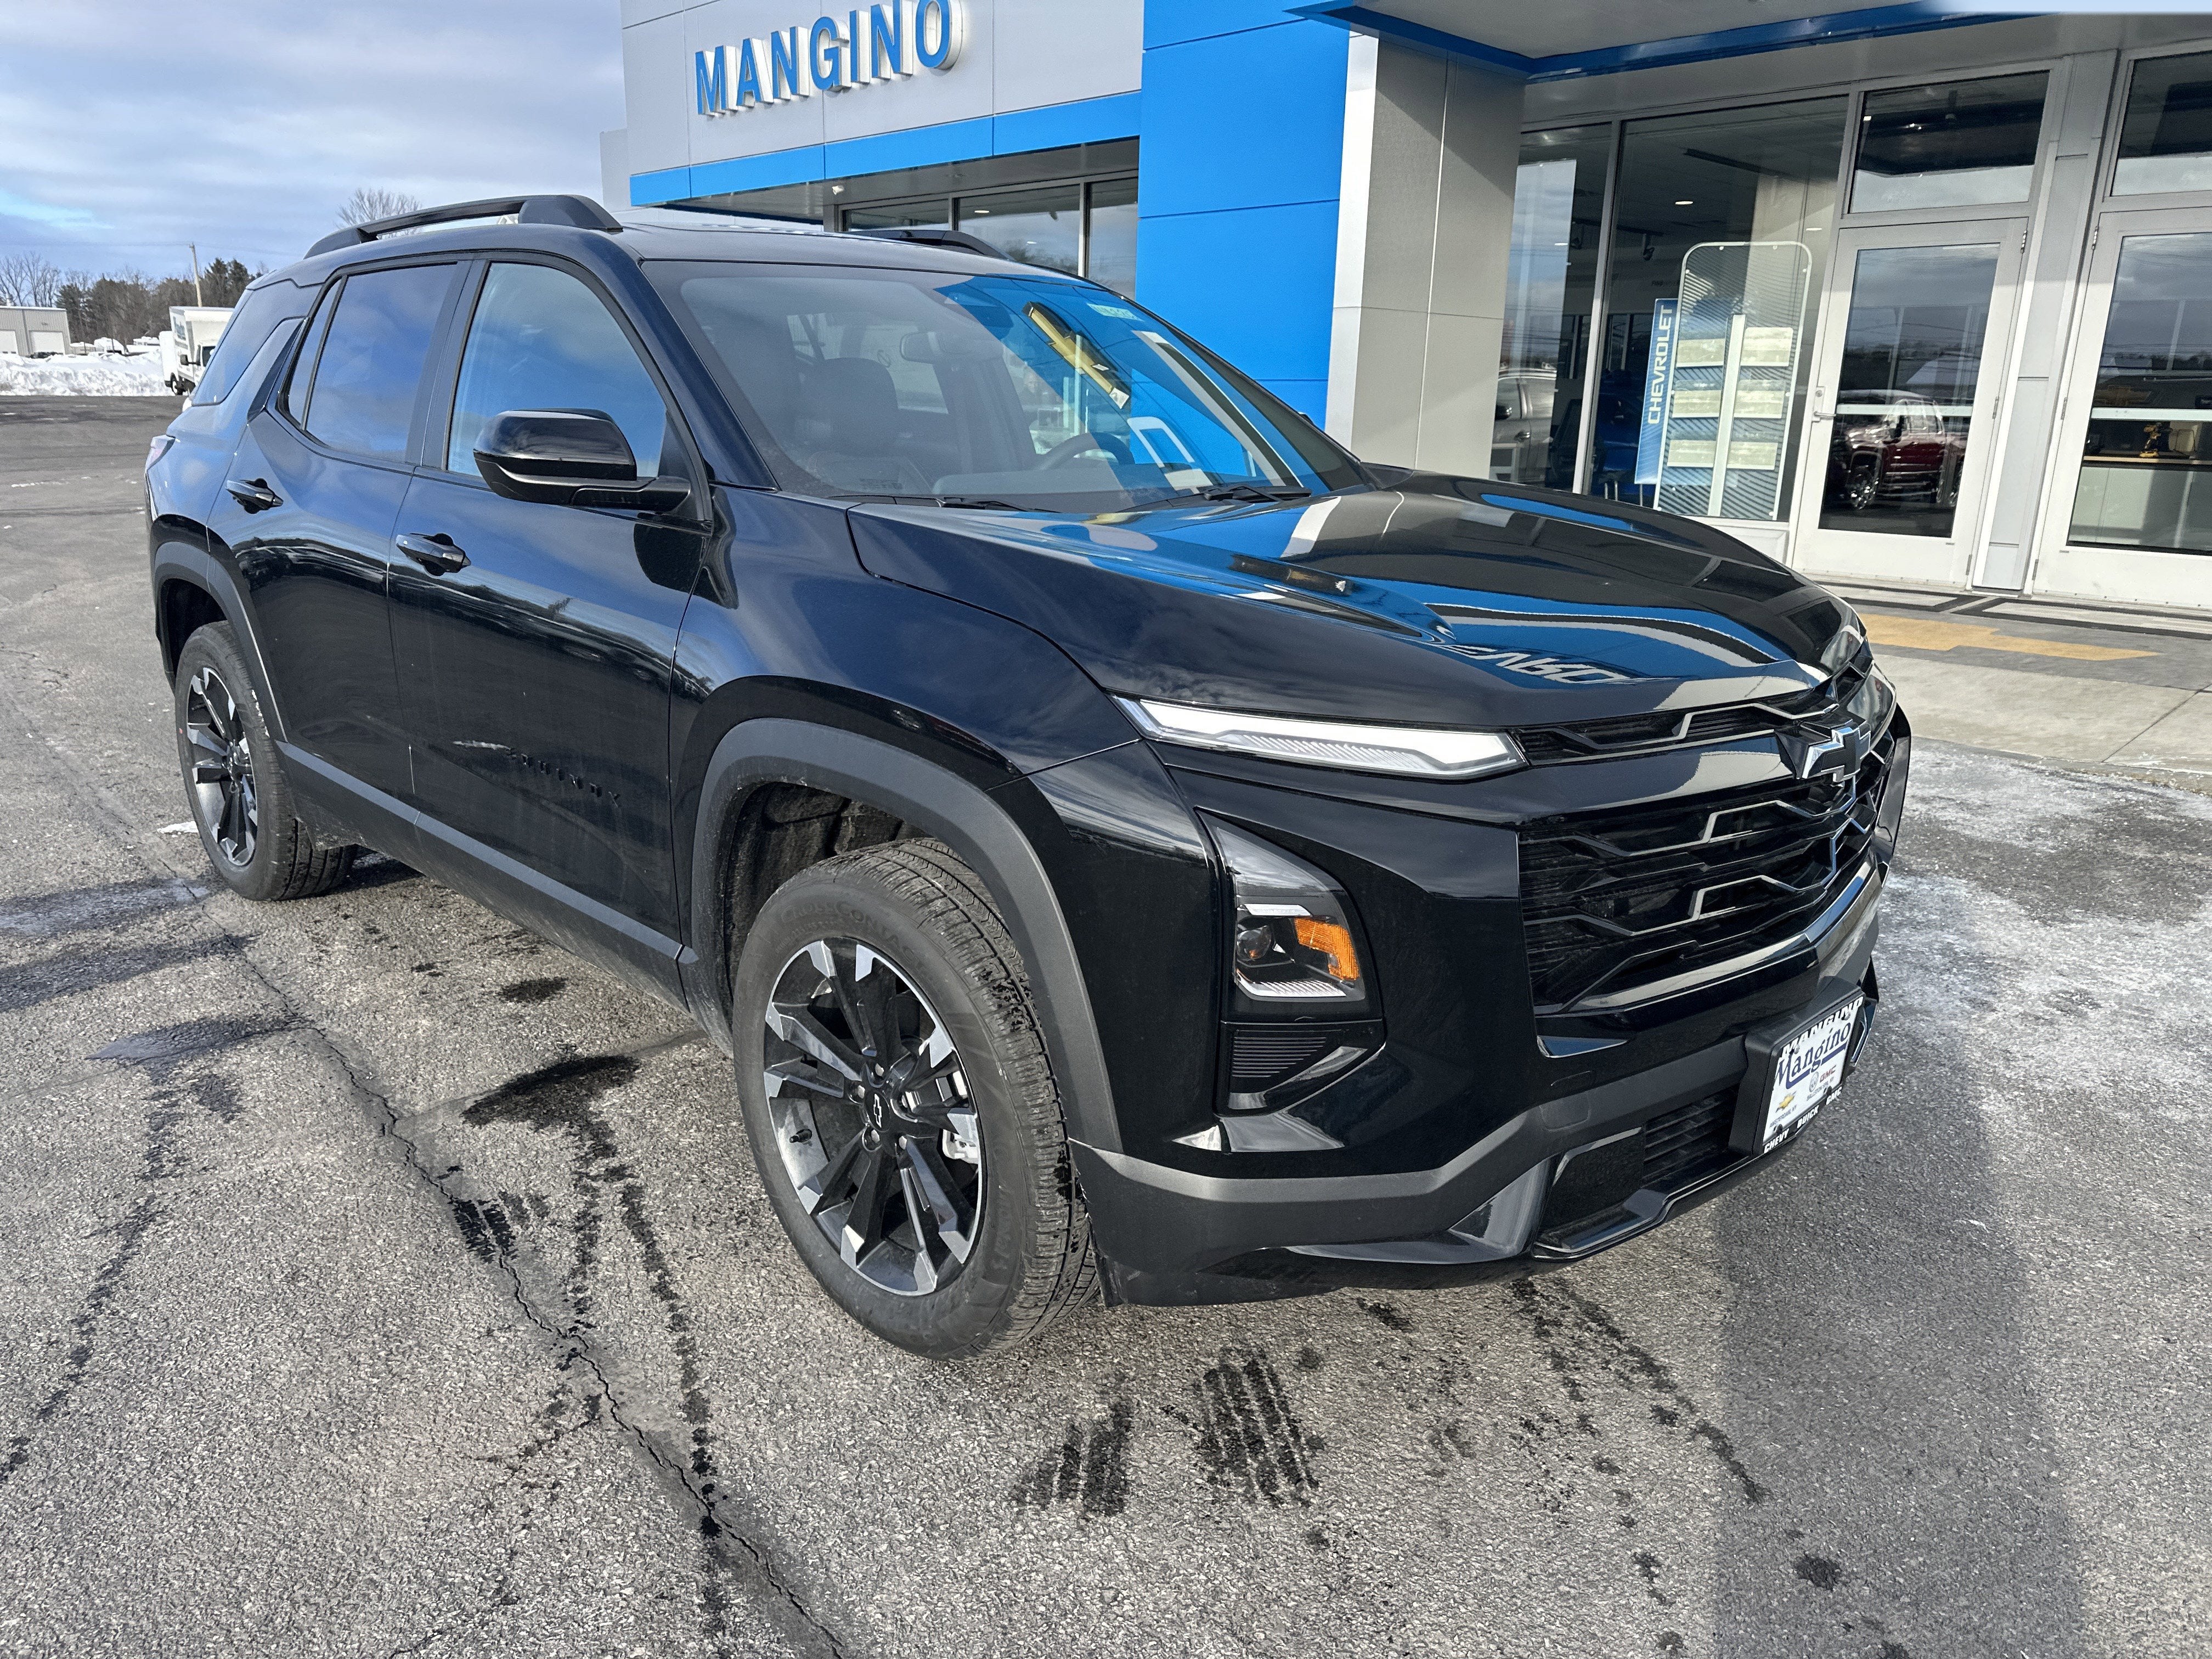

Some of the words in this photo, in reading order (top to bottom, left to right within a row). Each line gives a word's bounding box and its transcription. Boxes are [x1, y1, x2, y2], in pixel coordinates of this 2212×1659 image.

[695, 0, 962, 116] MANGINO
[1648, 305, 1672, 424] CHEVROLET
[1774, 1022, 1851, 1089] Mangino
[1782, 996, 1863, 1057] MANGINO
[1820, 1065, 1836, 1082] GMC
[1764, 1128, 1790, 1153] CHEVY
[1797, 1105, 1819, 1128] BUICK
[1826, 1086, 1842, 1105] GMC
